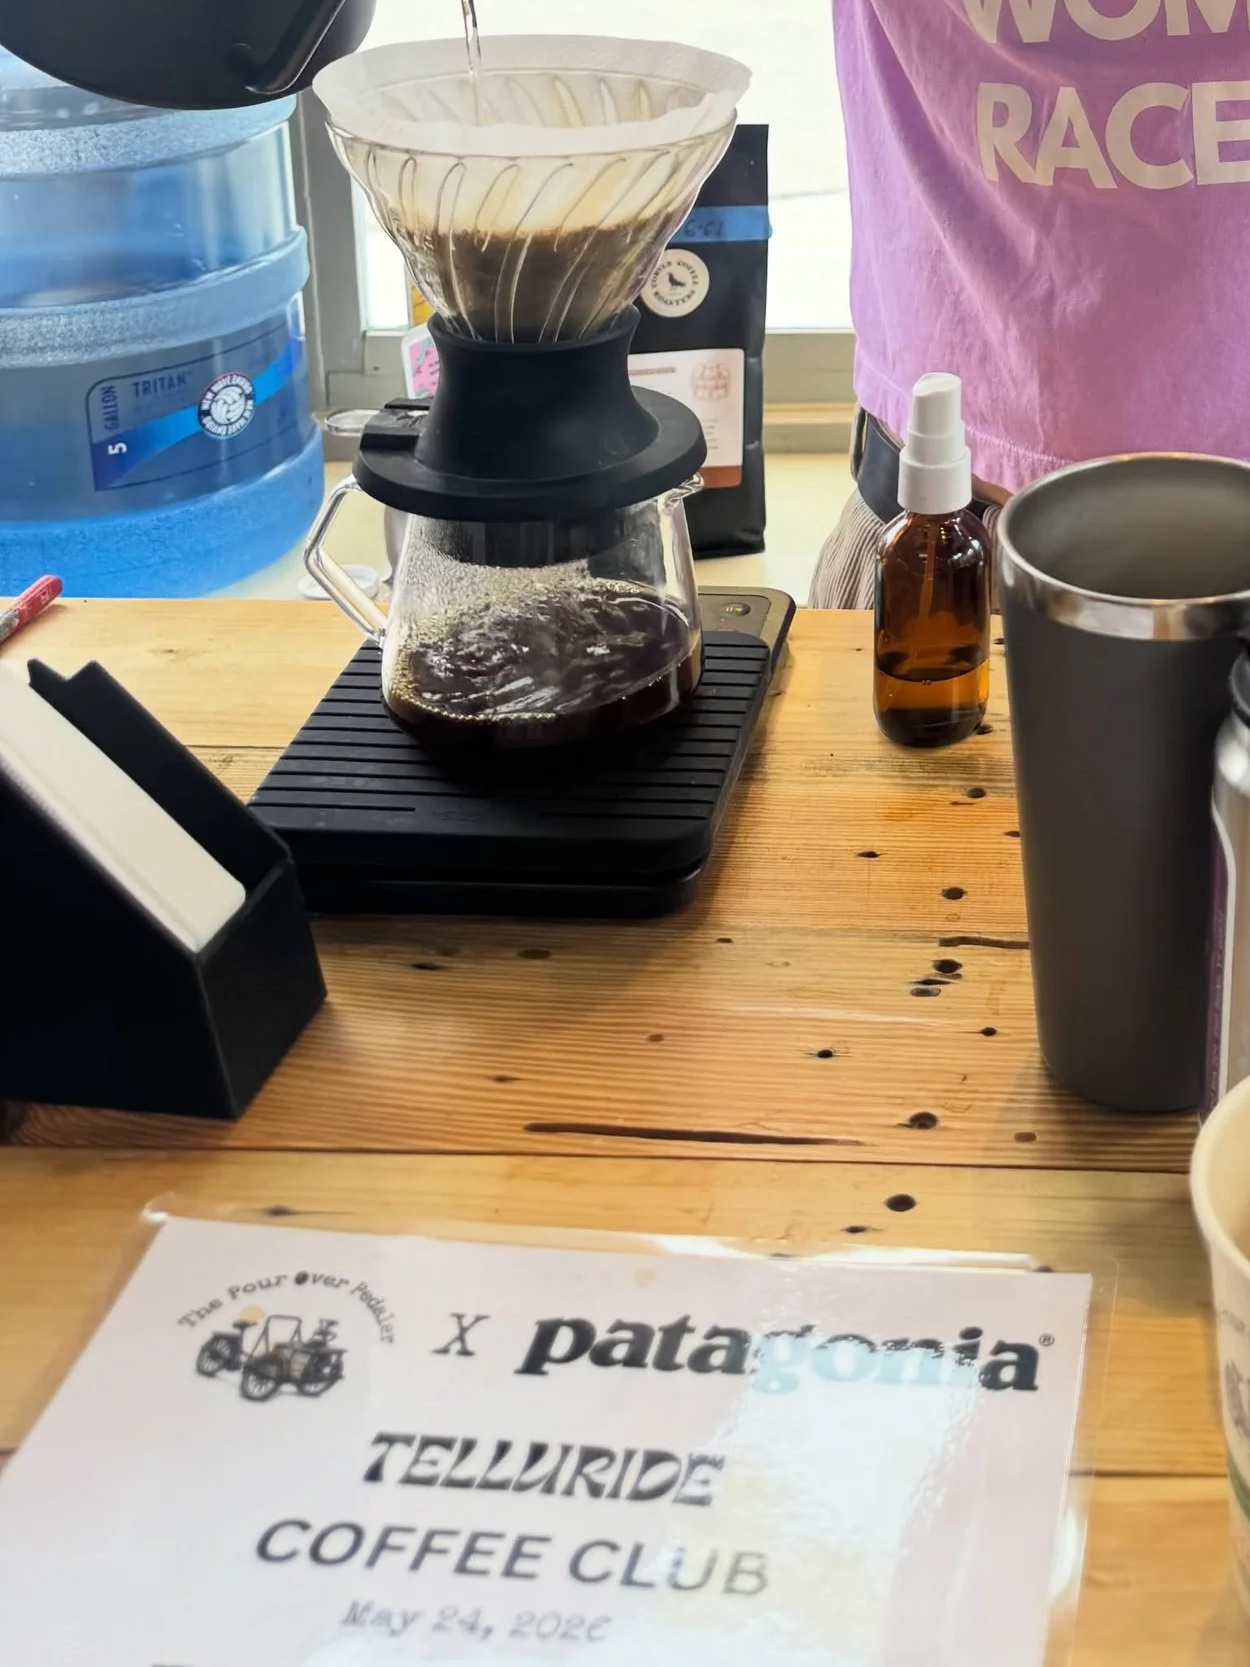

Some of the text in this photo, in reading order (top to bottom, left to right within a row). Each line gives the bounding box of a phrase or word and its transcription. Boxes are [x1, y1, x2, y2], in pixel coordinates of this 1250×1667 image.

[101, 385, 127, 455] 5 GALLON
[132, 374, 188, 398] TRITAN
[177, 1271, 397, 1345] The Pour Over Pedaler
[361, 1432, 726, 1507] TELLURIDE
[256, 1516, 770, 1598] COFFEE CLUB
[341, 1598, 423, 1636] May
[432, 1605, 494, 1641] 24,
